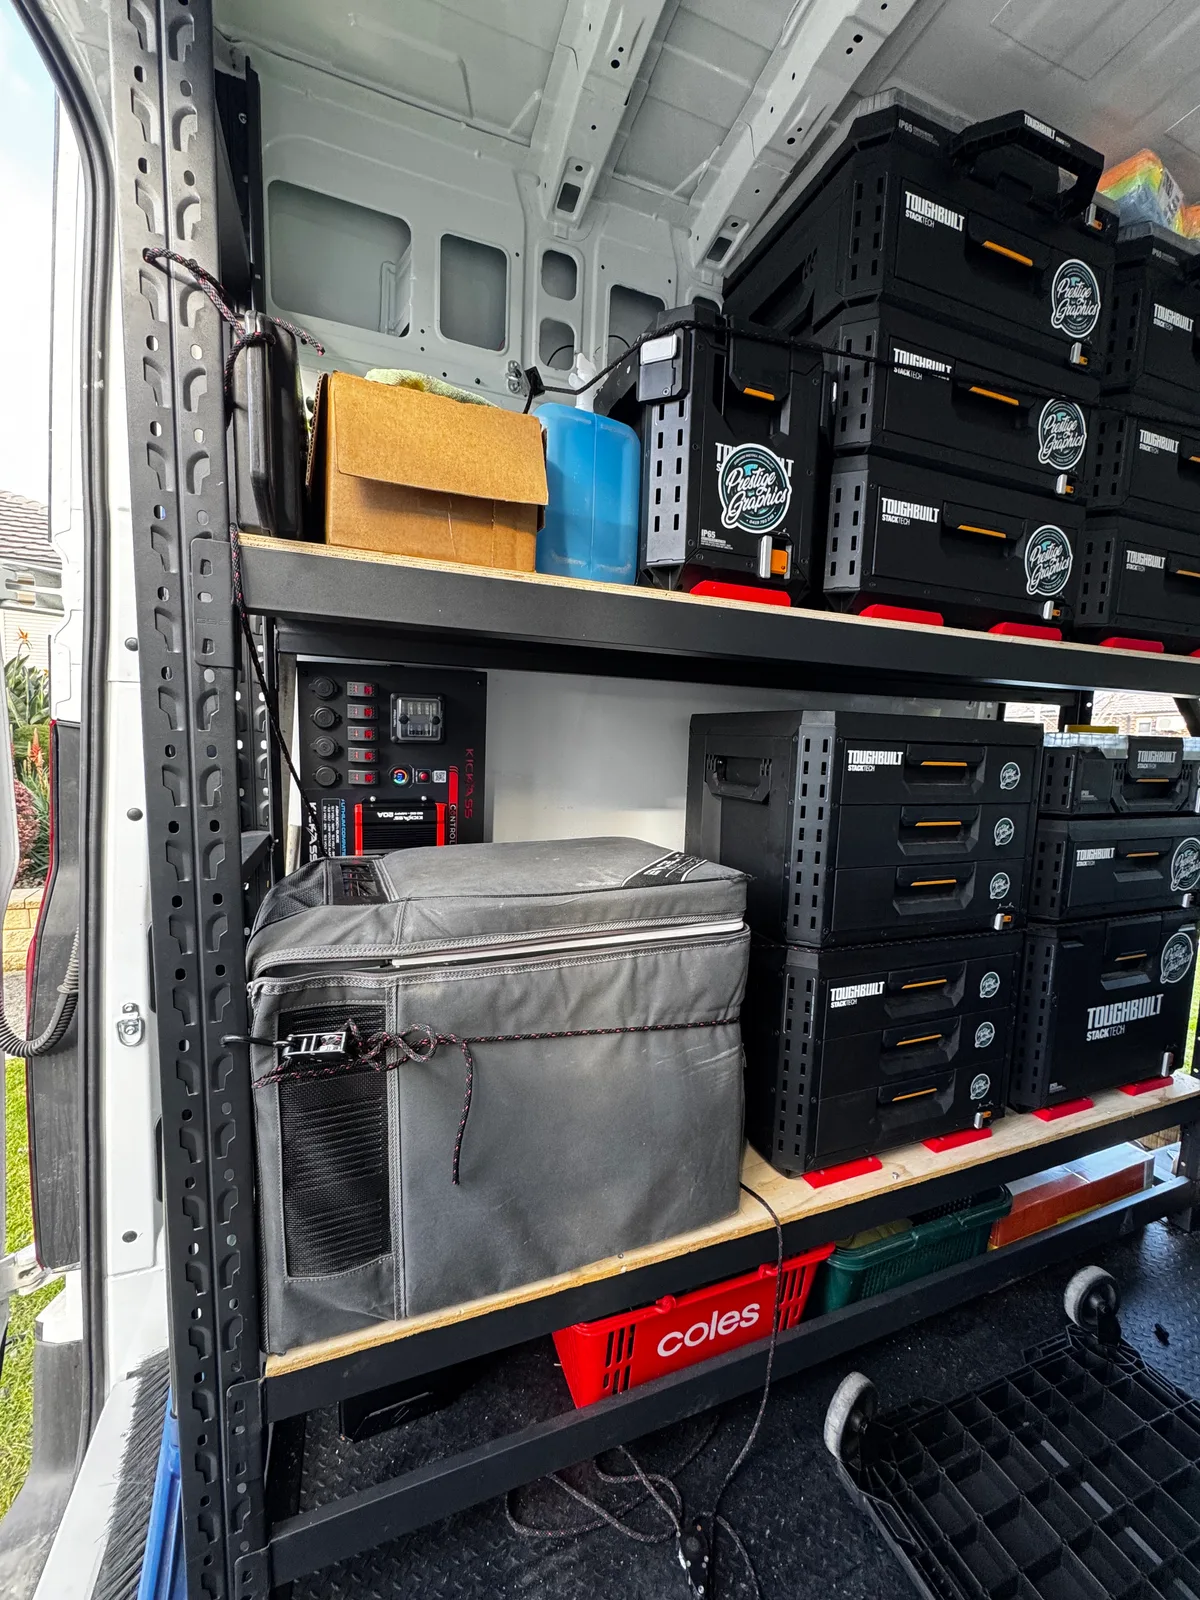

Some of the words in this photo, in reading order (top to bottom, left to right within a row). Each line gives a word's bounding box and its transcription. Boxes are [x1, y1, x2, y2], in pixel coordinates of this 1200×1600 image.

[905, 191, 965, 232] TOUGHBUILT
[905, 209, 935, 228] STACKTECH
[1055, 277, 1092, 303] Prestige
[1054, 299, 1098, 323] Graphics
[1153, 303, 1194, 333] TOUGHBUILT
[1043, 416, 1078, 439] Prestige
[1041, 433, 1085, 460] Graphics
[1139, 429, 1179, 454] TOUGHBUILT
[726, 467, 776, 496] Prestige
[726, 487, 788, 524] Graphics
[881, 497, 939, 523] TOUGHBUILT
[881, 513, 910, 526] STACKTECH
[701, 528, 716, 540] IP65
[1029, 542, 1063, 564] Prestige
[1126, 550, 1166, 570] TOUGHBUILT
[1028, 557, 1070, 587] Graphics
[847, 750, 903, 765] TOUGHBUILT
[1137, 750, 1177, 763] TOUGHBUILT
[1076, 847, 1115, 861] TOUGHBUILT
[830, 981, 885, 1002] TOUGHBUILT
[830, 999, 857, 1008] STACKTECH
[1086, 993, 1164, 1030] TOUGHBUILT
[1086, 1024, 1126, 1041] STACKTECH
[657, 1303, 760, 1357] coles
